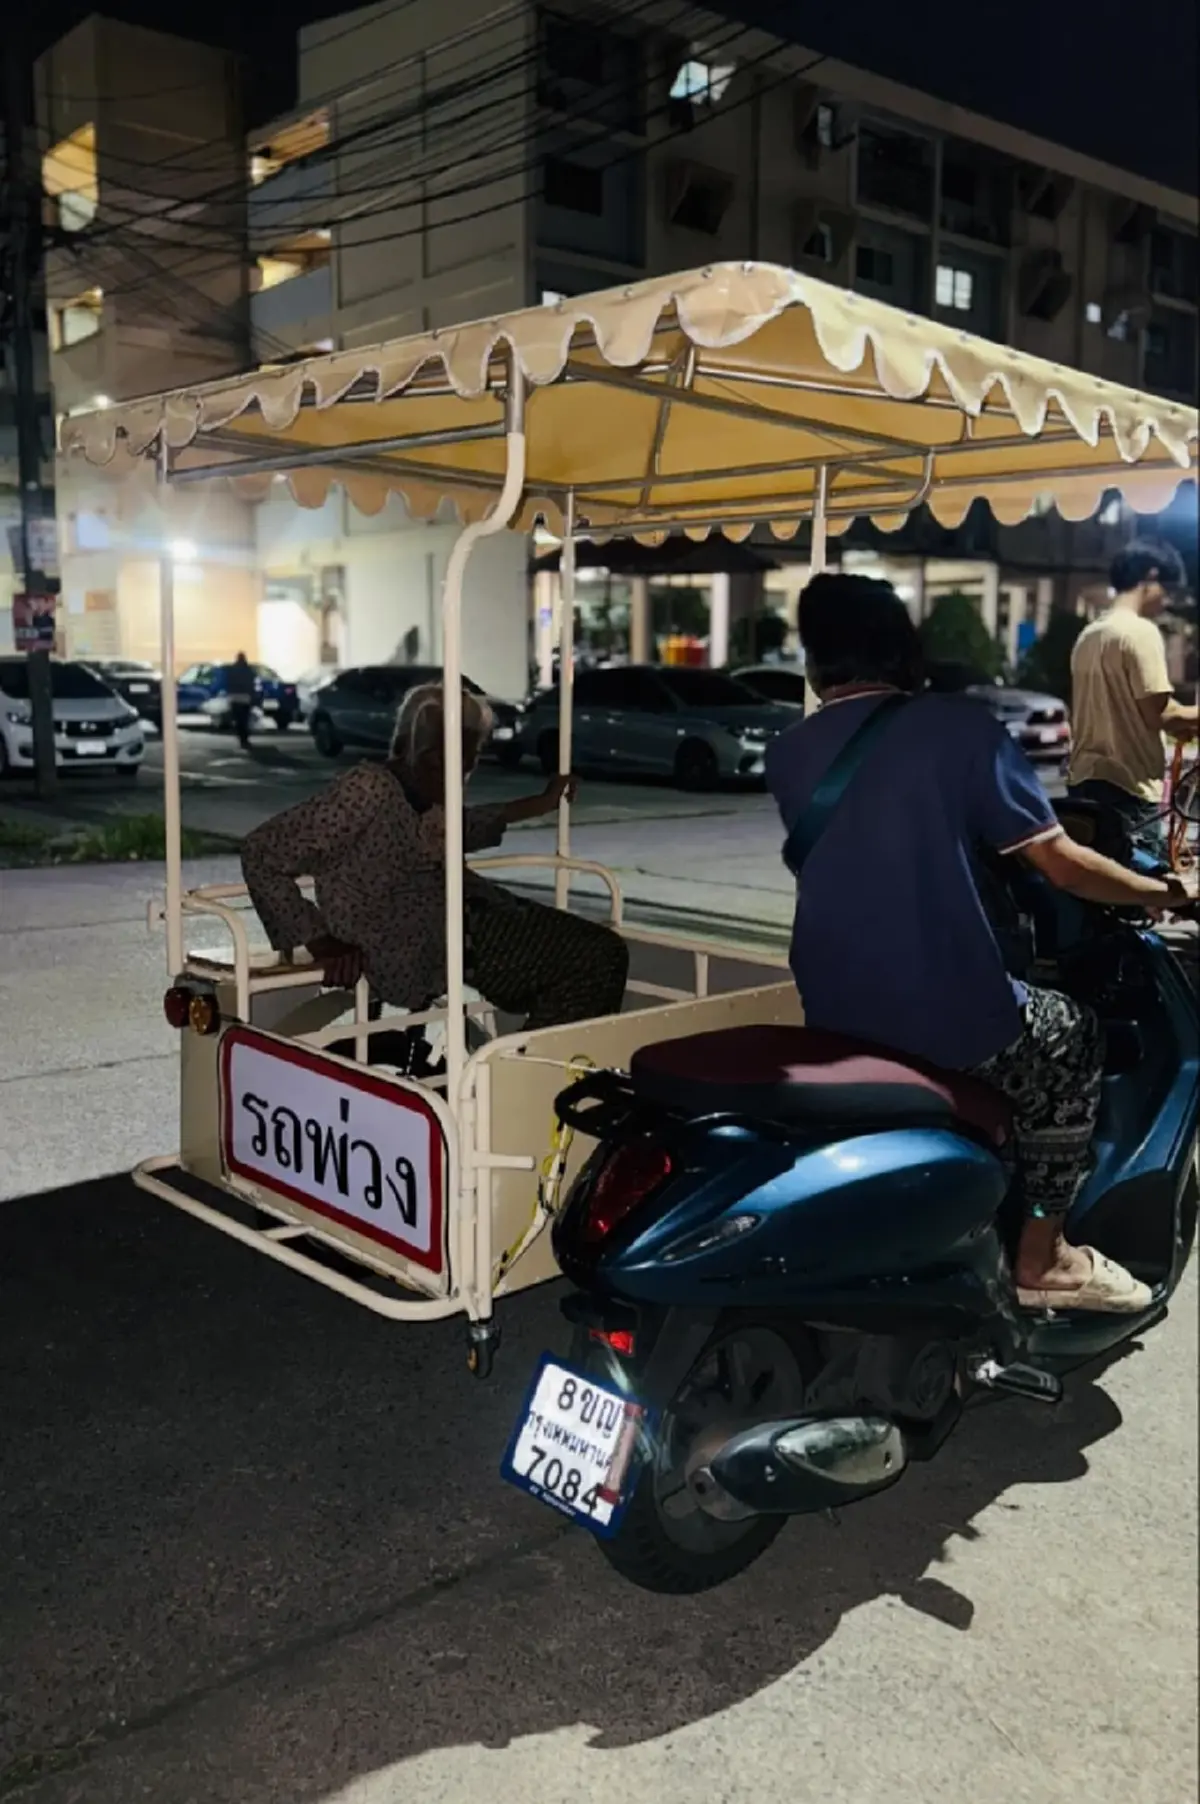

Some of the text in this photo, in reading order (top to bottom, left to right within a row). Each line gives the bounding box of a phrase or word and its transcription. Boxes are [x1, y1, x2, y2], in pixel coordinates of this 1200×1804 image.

[242, 1092, 417, 1228] รถพ่วง
[526, 1445, 600, 1515] 7084
